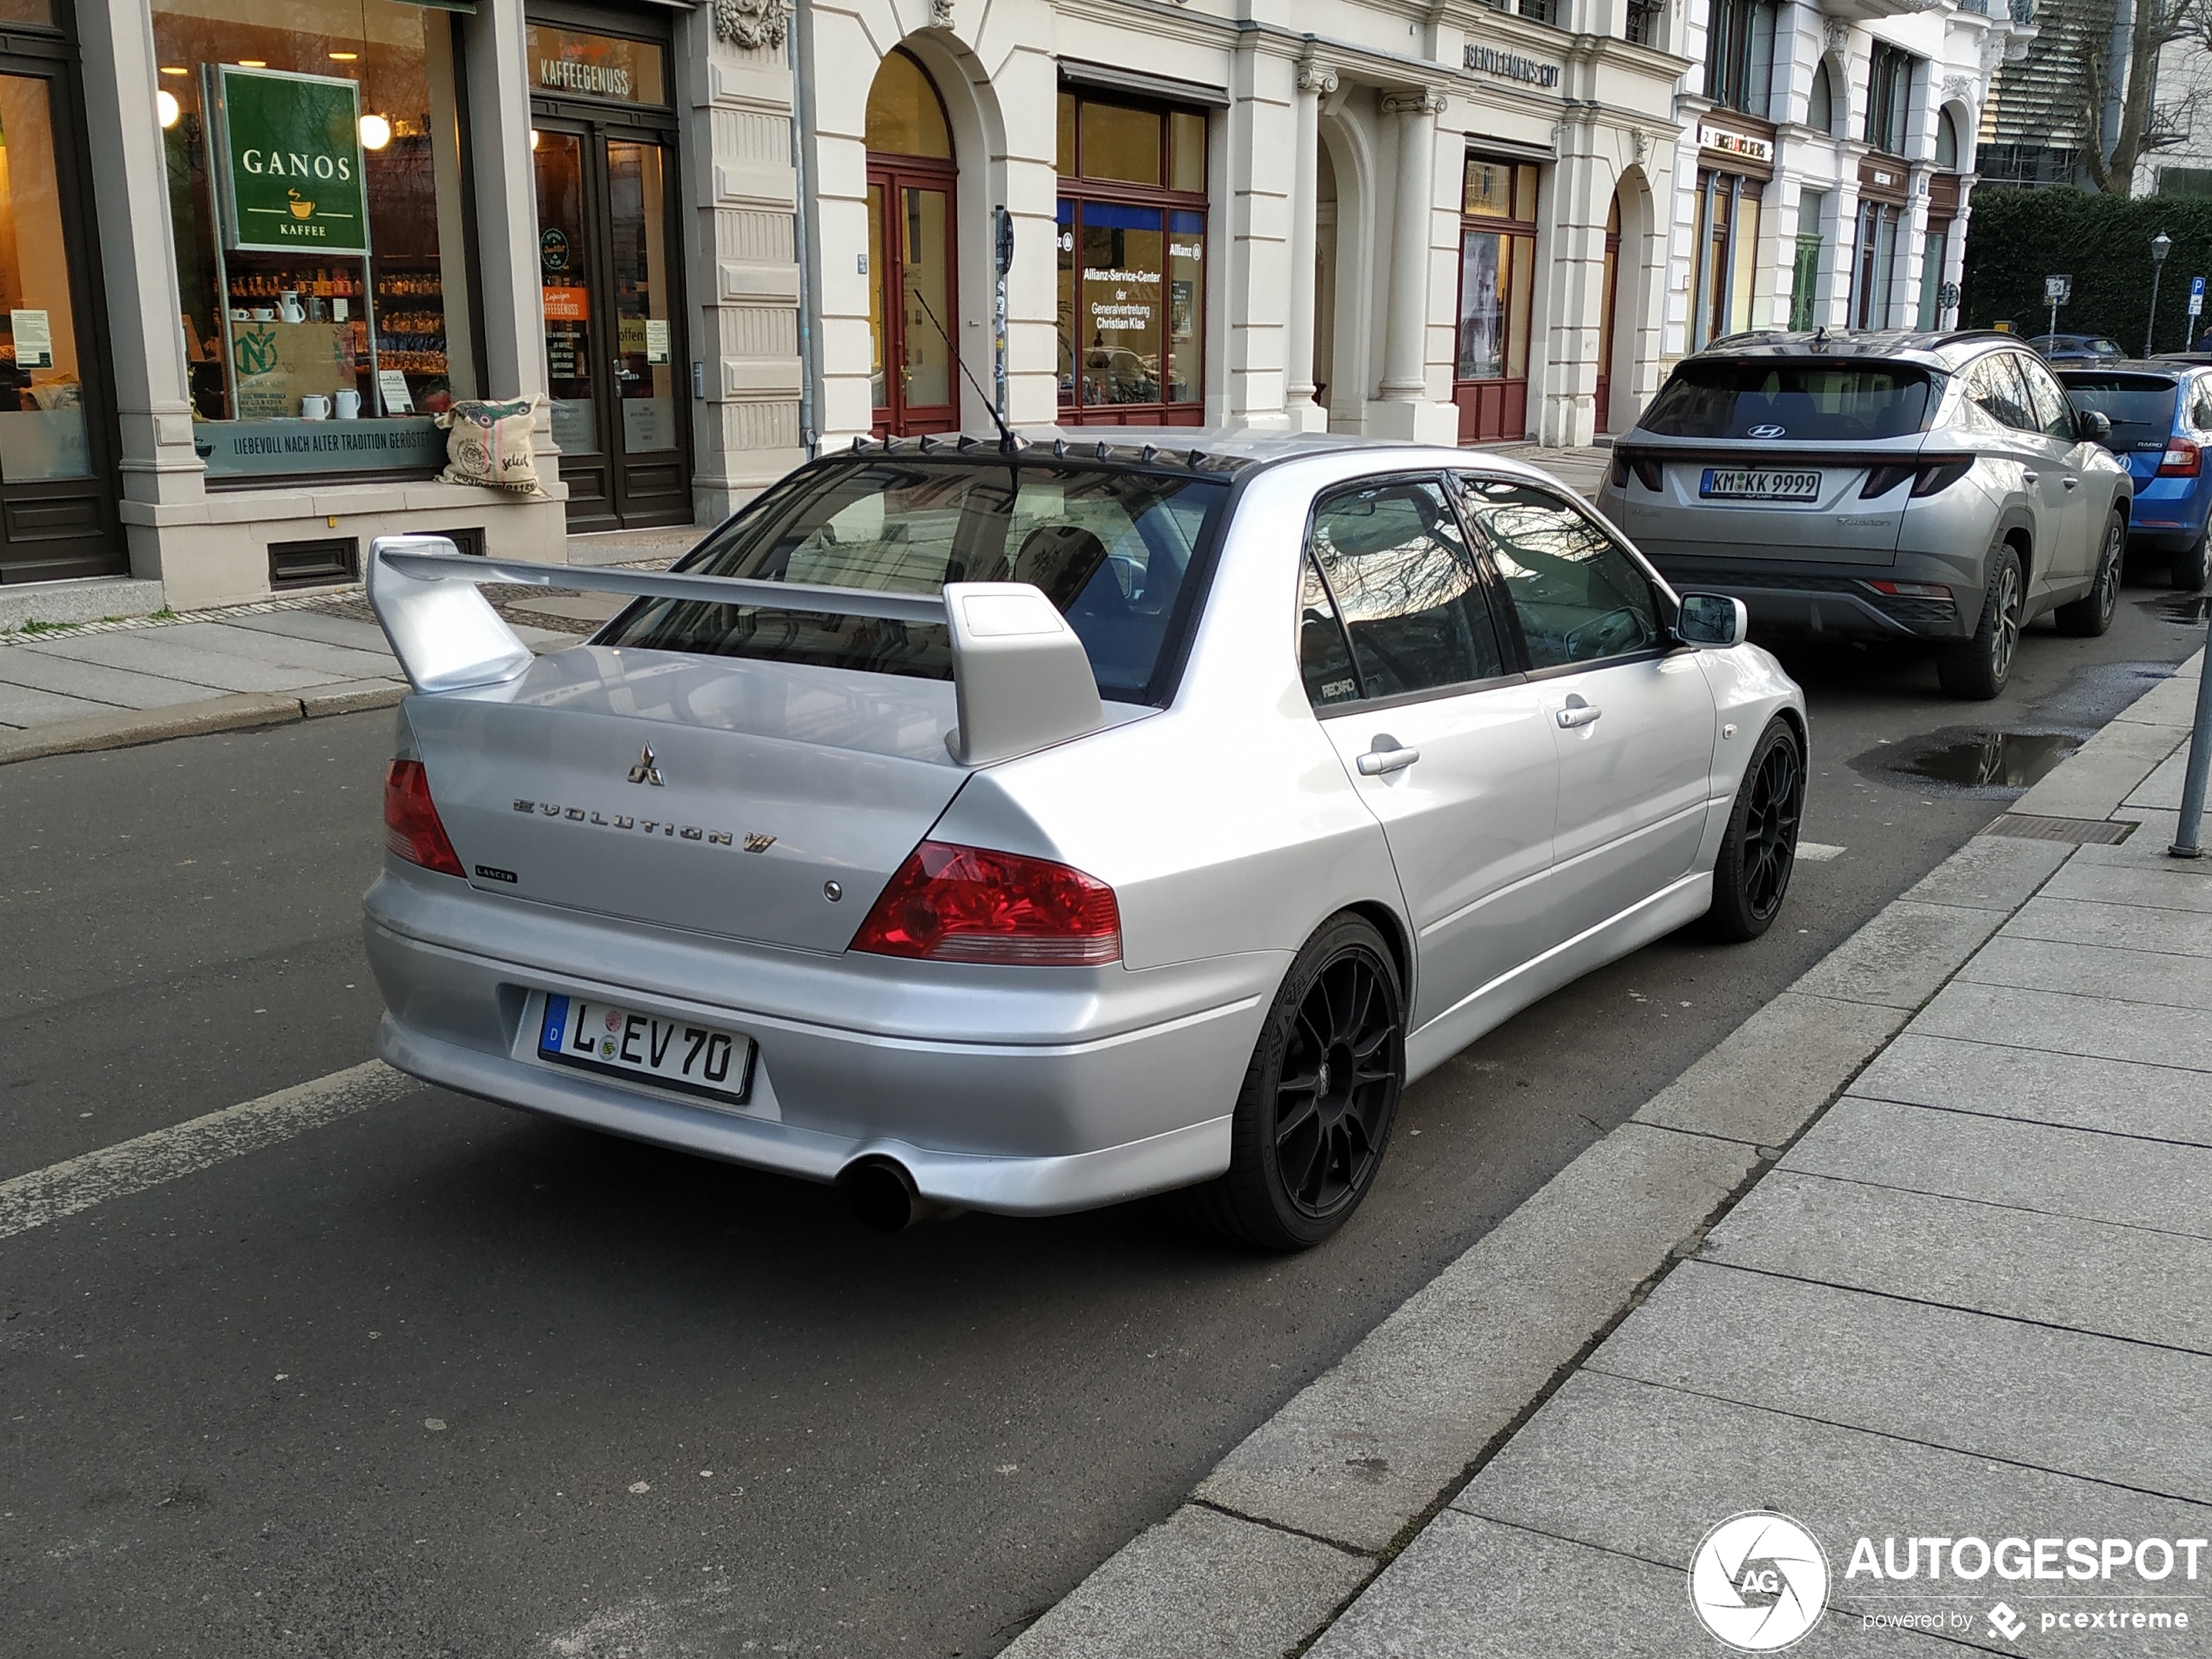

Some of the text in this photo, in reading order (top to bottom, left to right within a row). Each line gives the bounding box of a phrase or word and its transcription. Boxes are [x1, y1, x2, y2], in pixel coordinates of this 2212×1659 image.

[540, 58, 629, 96] KAFFEEGENUSS
[1541, 64, 1561, 87] CUT
[243, 149, 350, 180] GANOS
[280, 224, 326, 236] KAFFEE
[1170, 243, 1192, 257] Allianz
[1083, 267, 1161, 283] Allianz-Service-Center
[1116, 288, 1128, 300] der
[2195, 280, 2202, 293] P
[1091, 302, 1150, 318] Generalvertretung
[1096, 316, 1146, 330] Christian Klas
[233, 429, 429, 455] LIEBEVOLL NACH ALTER TRADITION GERÖSTET
[502, 453, 529, 471] select
[1712, 473, 1816, 494] KM KK 9999
[1321, 678, 1355, 698] RECARO
[513, 799, 732, 846] EVOLUTION
[476, 867, 514, 882] LANCER
[550, 1028, 558, 1041] D
[573, 1004, 732, 1082] L EV 70
